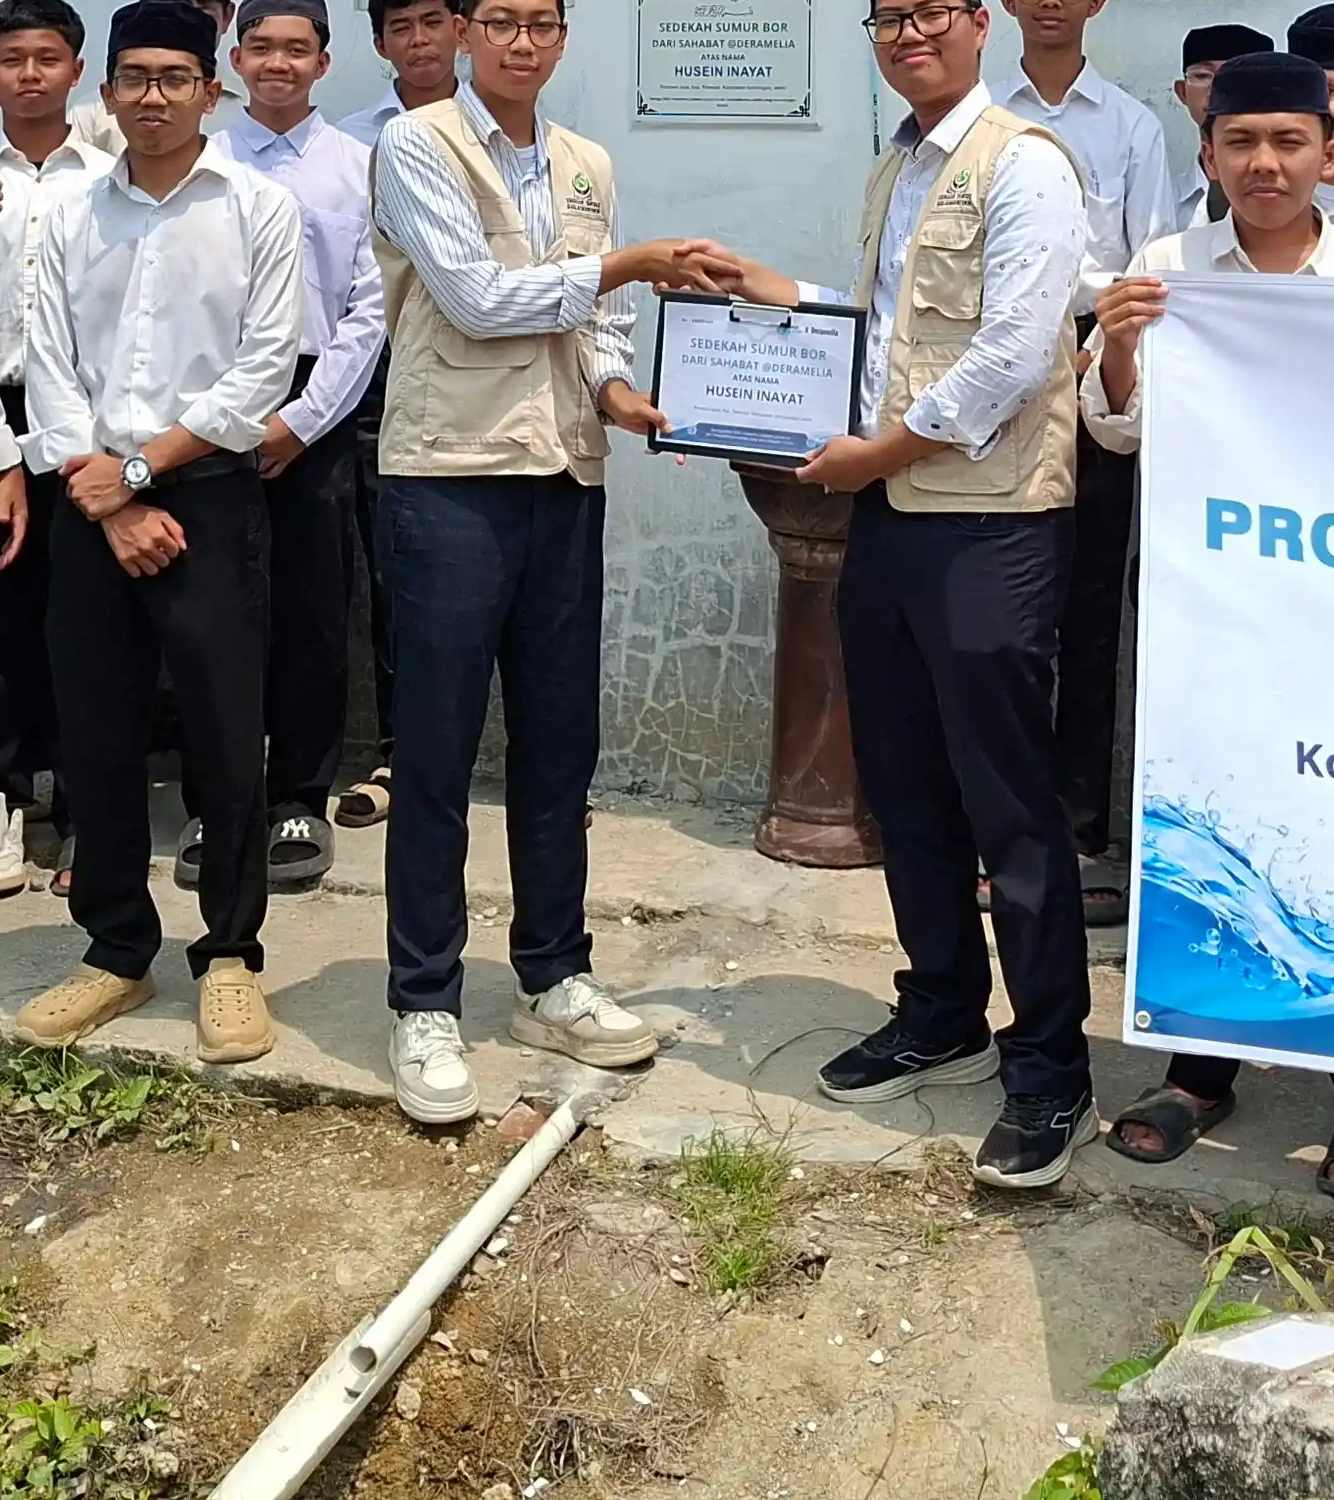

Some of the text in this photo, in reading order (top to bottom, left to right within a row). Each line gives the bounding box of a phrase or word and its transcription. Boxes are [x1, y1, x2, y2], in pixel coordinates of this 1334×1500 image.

[659, 22, 788, 33] SEDEKAH SUMUR BOR
[652, 39, 796, 49] DARI SAHABAT @DERAMELIA
[700, 53, 746, 61] ATAS NAMA
[675, 65, 773, 78] HUSEIN INAYAT
[690, 337, 826, 361] SEDEKAH SUMUR BOR
[681, 354, 833, 378] DARI SAHABAT @DERAMELIA
[732, 373, 752, 383] ATAS
[706, 384, 805, 405] HUSEIN INAYAT
